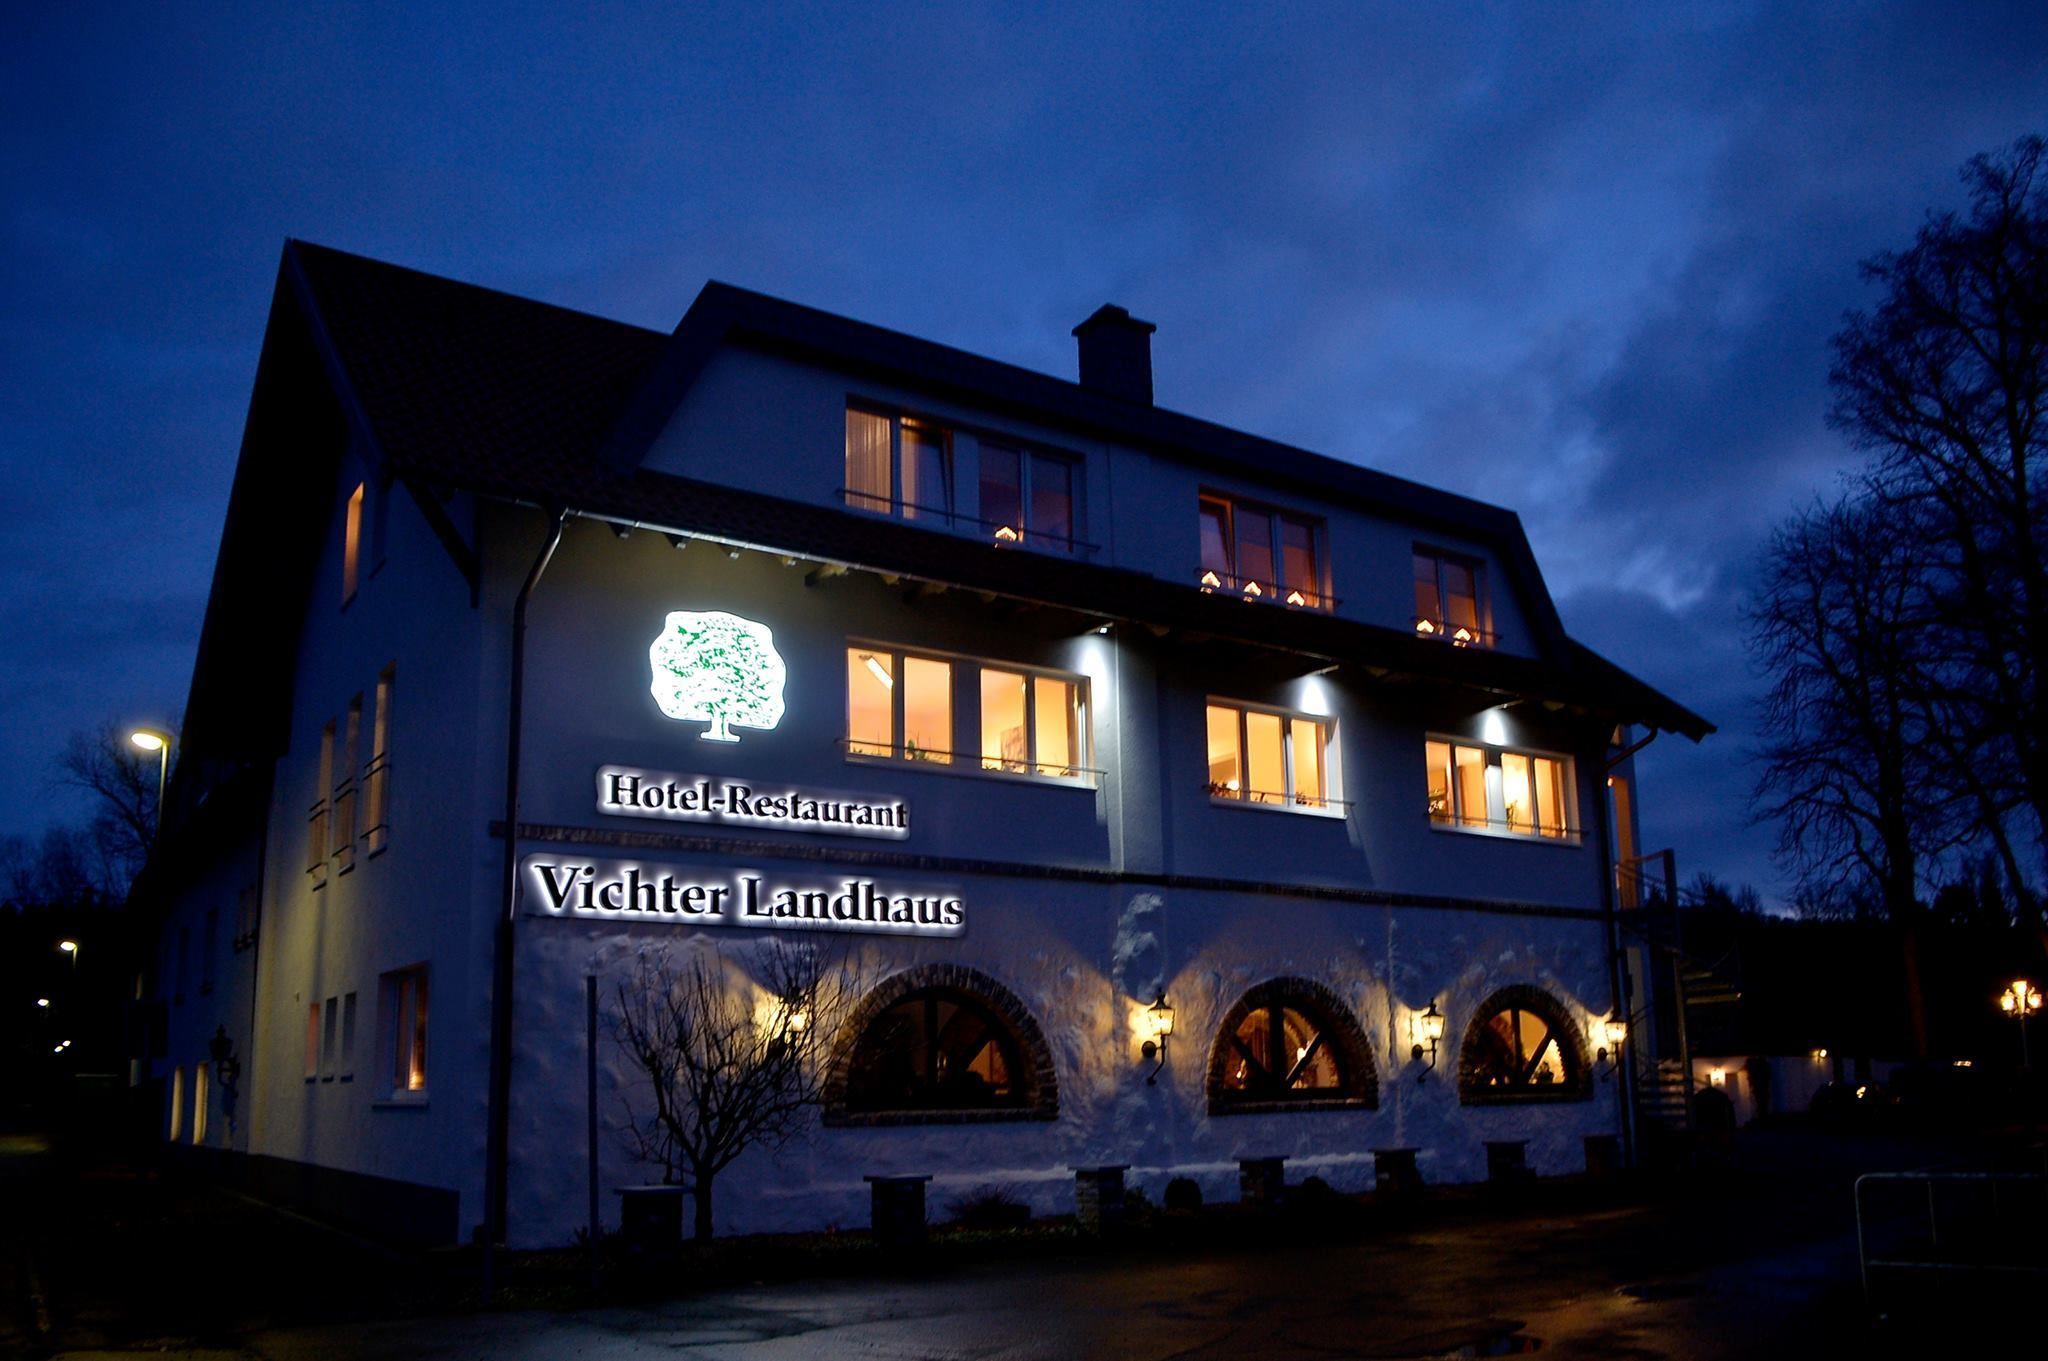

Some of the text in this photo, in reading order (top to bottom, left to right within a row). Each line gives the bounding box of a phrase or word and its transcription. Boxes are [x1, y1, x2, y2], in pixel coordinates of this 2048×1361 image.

[606, 773, 908, 828] Hotel-Restaurant
[534, 863, 964, 925] Vichter Landhaus
